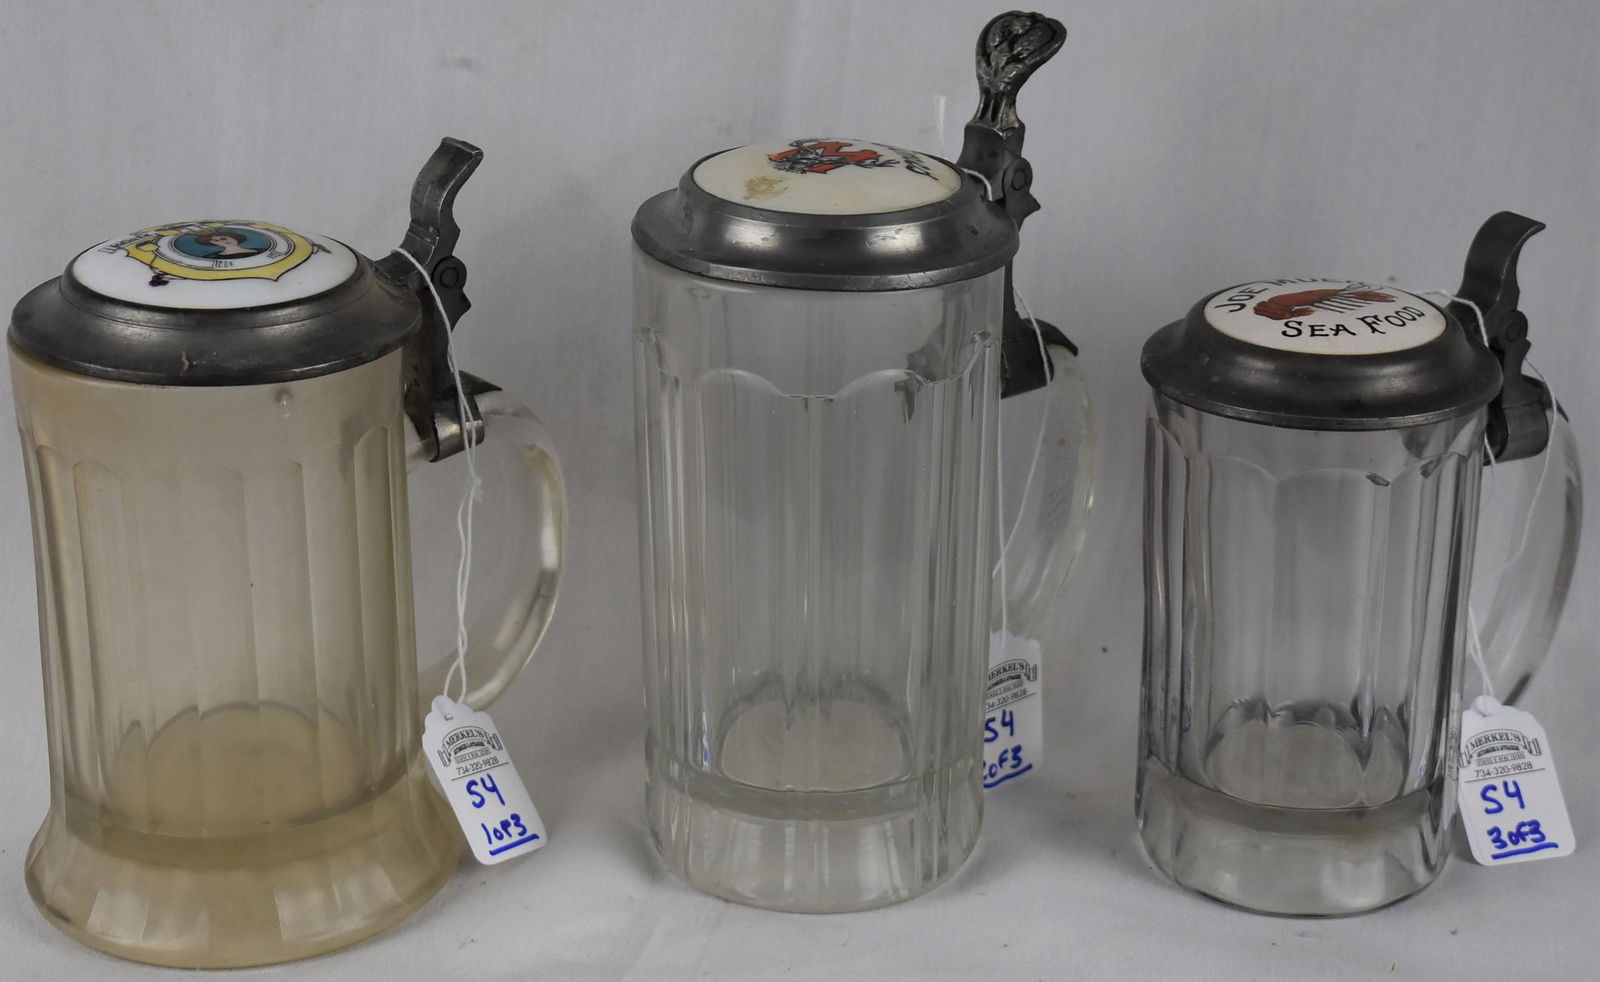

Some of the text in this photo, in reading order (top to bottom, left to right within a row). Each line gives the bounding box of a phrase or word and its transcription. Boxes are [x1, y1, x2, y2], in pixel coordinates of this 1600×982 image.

[1215, 286, 1269, 313] JOE
[988, 661, 1024, 681] ERKEL'S
[987, 689, 1027, 709] 34-320-9828
[446, 729, 485, 747] MERKEL'S
[1470, 732, 1521, 749] MERKEL'S
[456, 756, 499, 775] 734-320-9828
[1474, 761, 1533, 778] 734-320-9828
